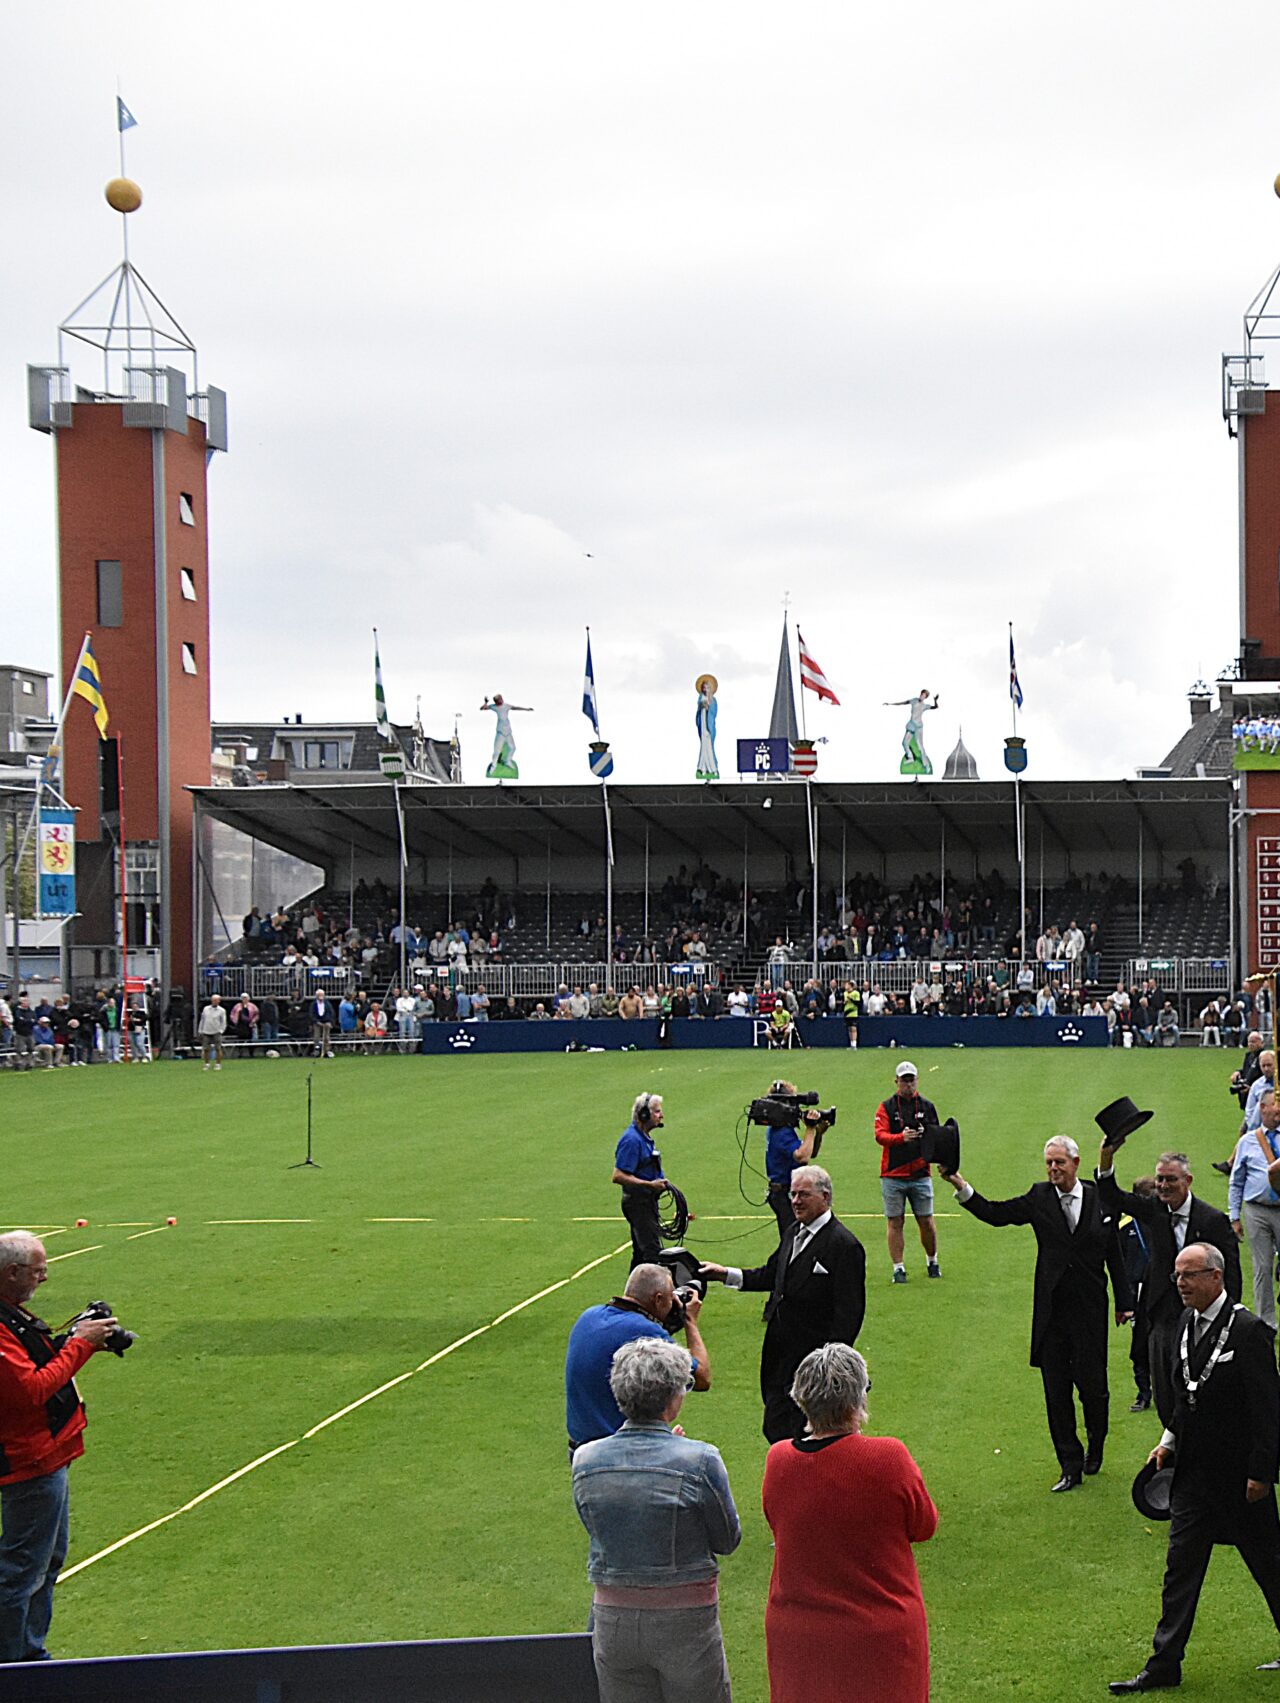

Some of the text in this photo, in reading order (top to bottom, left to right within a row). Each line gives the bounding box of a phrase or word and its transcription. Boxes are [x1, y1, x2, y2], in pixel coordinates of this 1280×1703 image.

[755, 753, 770, 770] PC
[1263, 857, 1269, 866] 3
[1263, 888, 1269, 897] 7
[1263, 906, 1269, 914] 9
